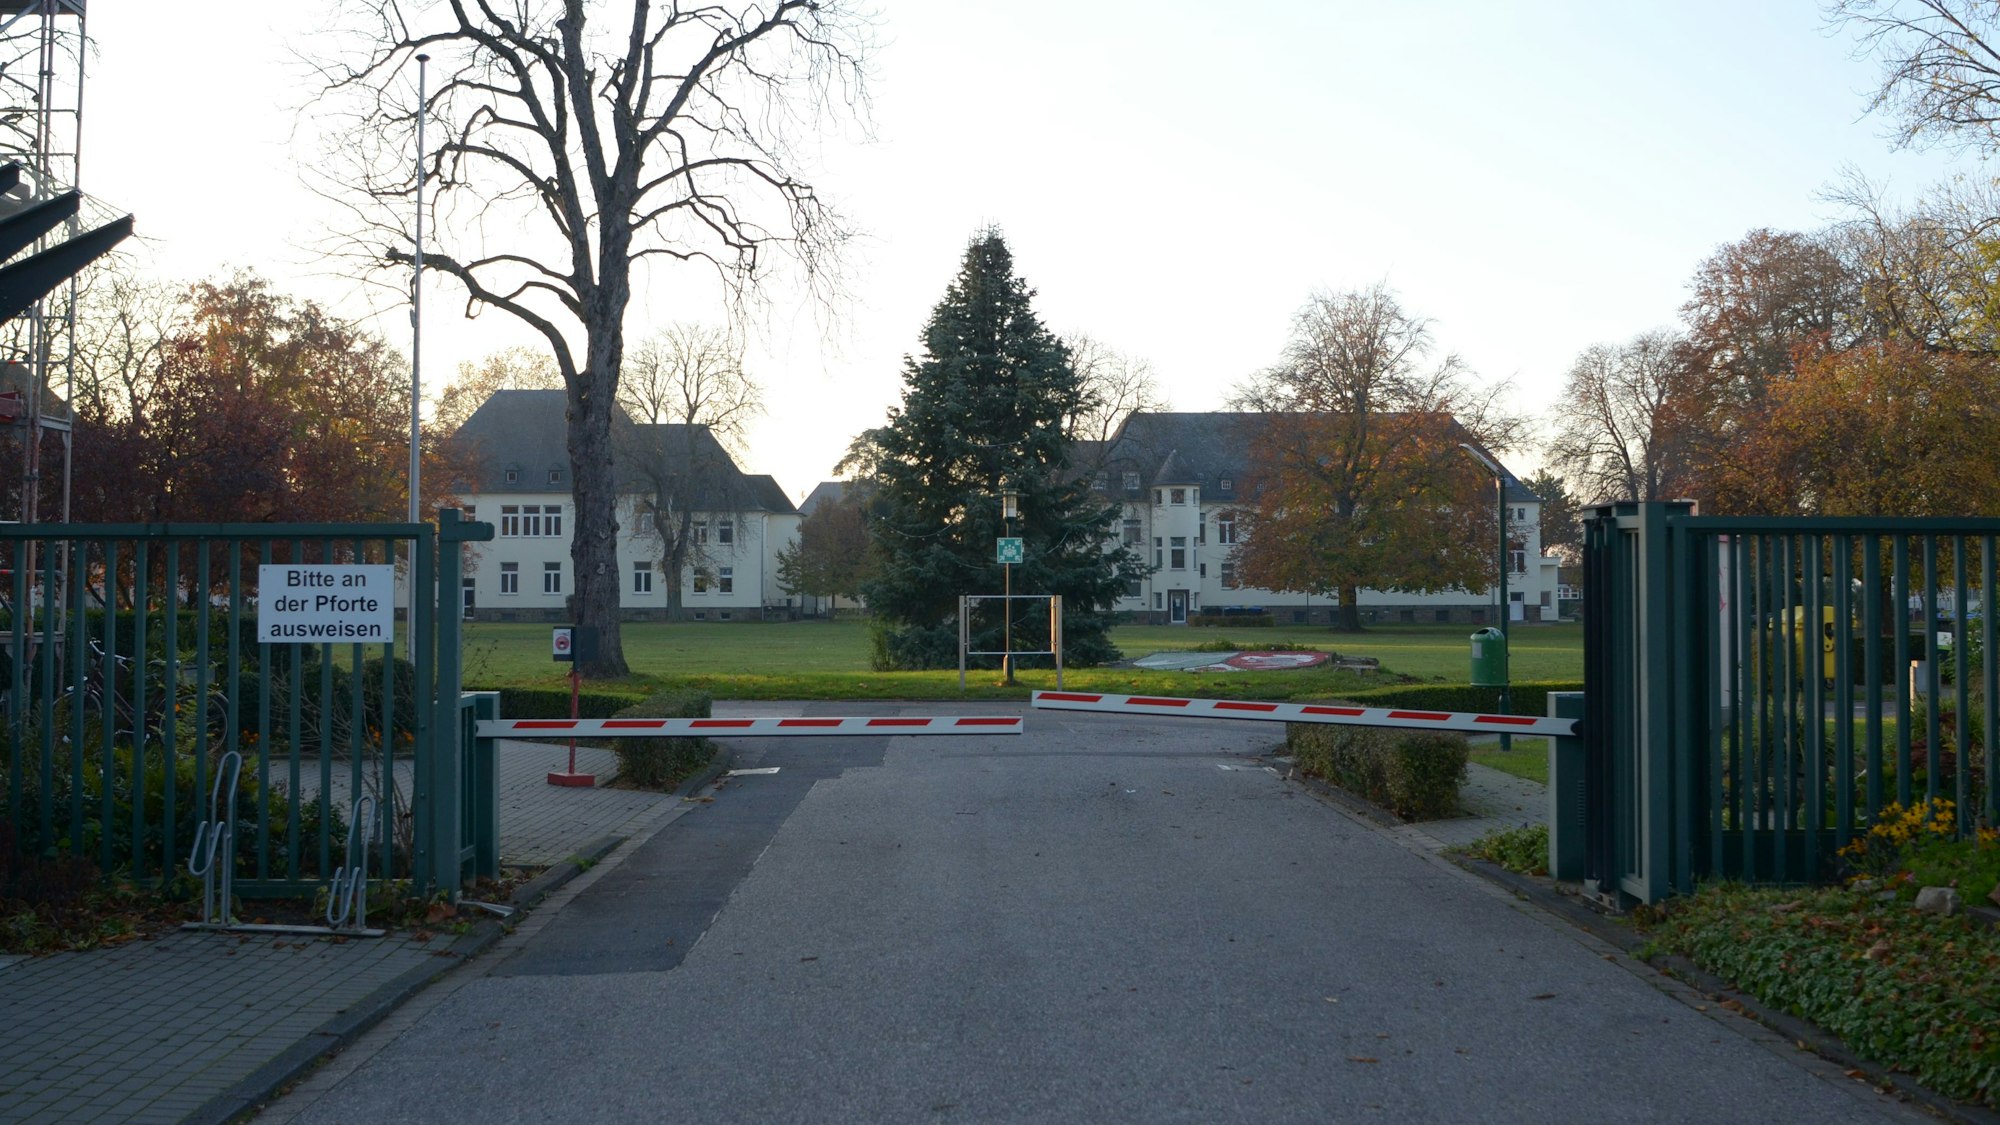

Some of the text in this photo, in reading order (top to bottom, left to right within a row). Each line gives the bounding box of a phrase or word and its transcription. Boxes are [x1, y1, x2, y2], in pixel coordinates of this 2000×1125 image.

[287, 570, 366, 587] Bitte an
[274, 595, 378, 612] der Pforte
[270, 620, 381, 637] ausweisen
